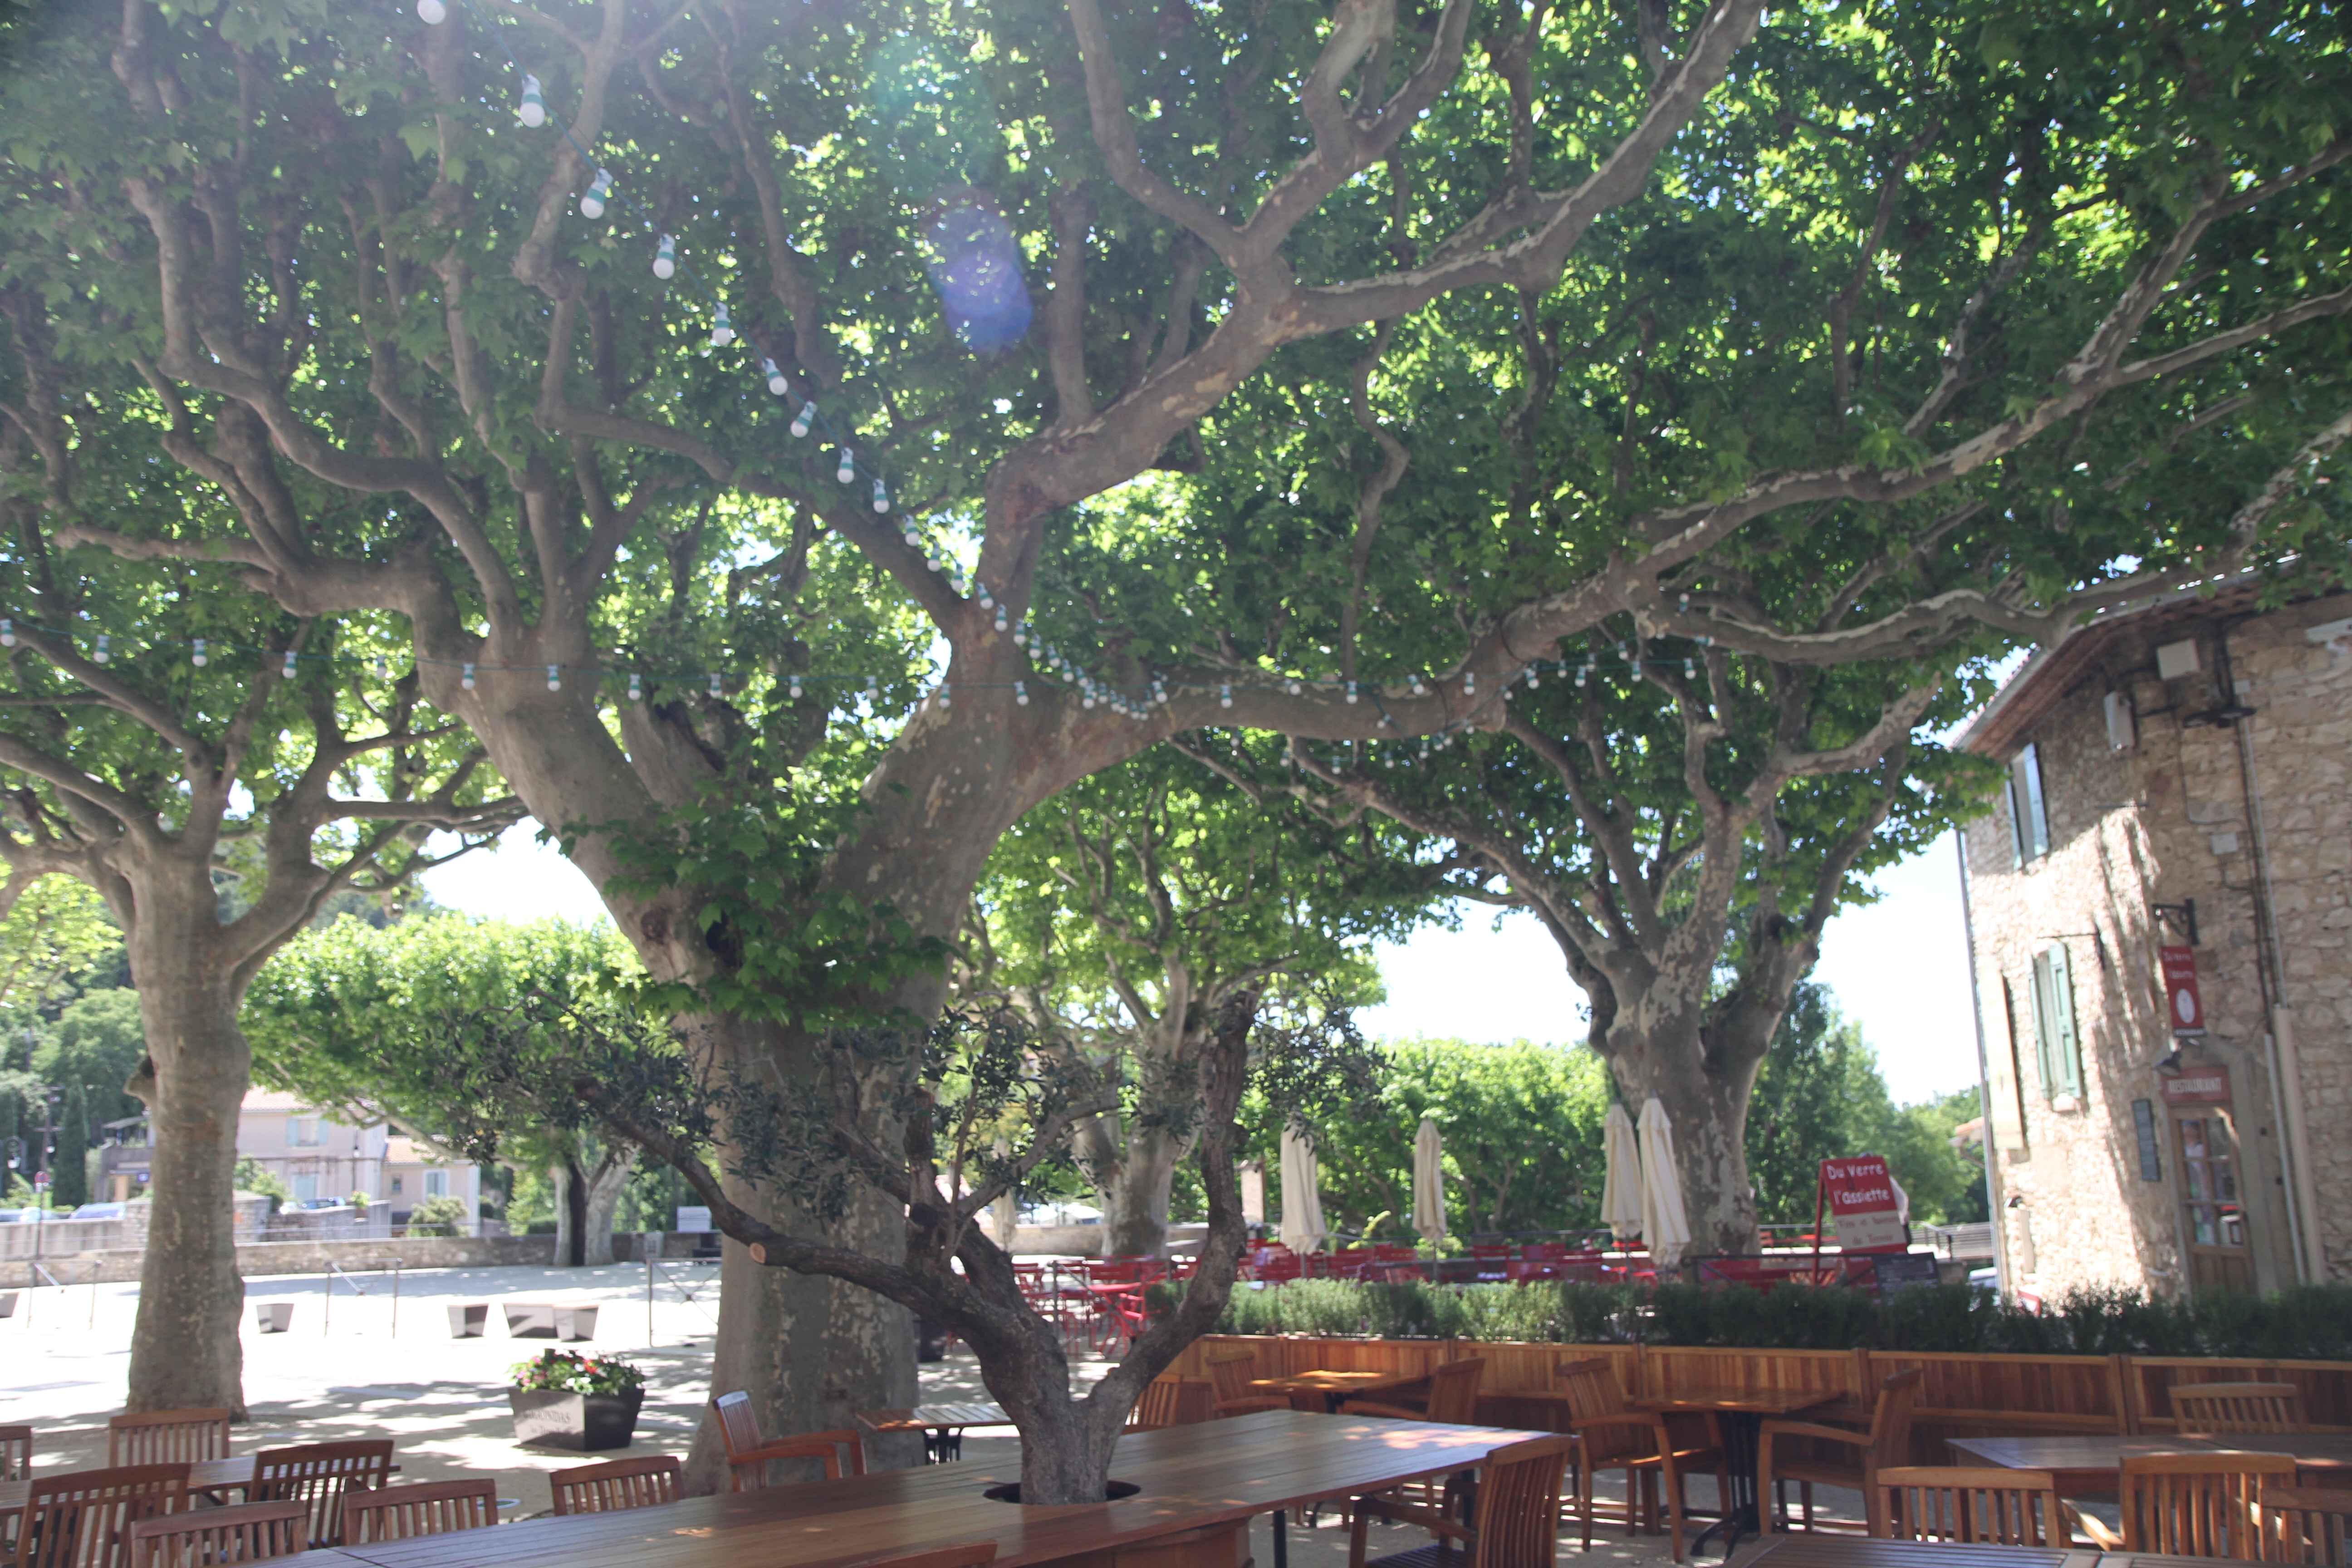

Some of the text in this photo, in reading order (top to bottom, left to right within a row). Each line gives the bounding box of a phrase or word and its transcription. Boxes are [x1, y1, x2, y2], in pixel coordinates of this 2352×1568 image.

[2167, 1077, 2222, 1093] RESTAURANT
[1826, 1164, 1884, 1180] Du Verre
[1833, 1188, 1891, 1205] l'assiette
